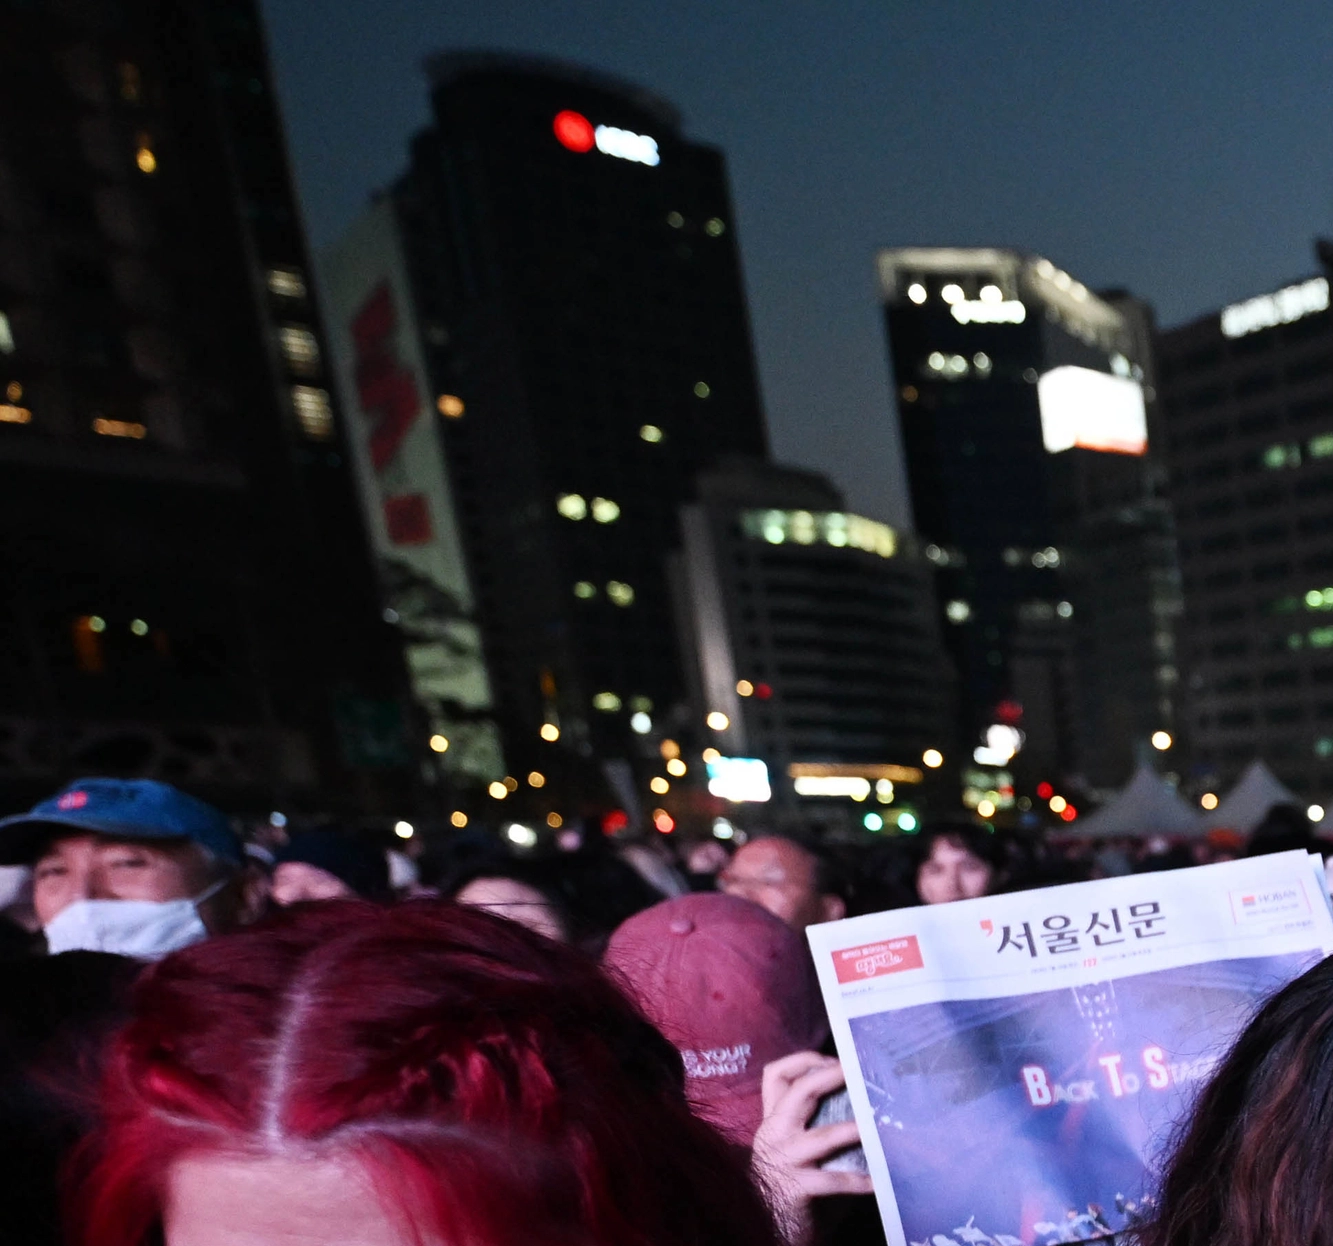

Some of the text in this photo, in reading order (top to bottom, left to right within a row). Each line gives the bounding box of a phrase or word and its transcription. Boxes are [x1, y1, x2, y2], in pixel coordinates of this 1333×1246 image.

[997, 901, 1166, 958] 서울신문
[1023, 1066, 1100, 1107] BACK
[1099, 1054, 1140, 1097] TO
